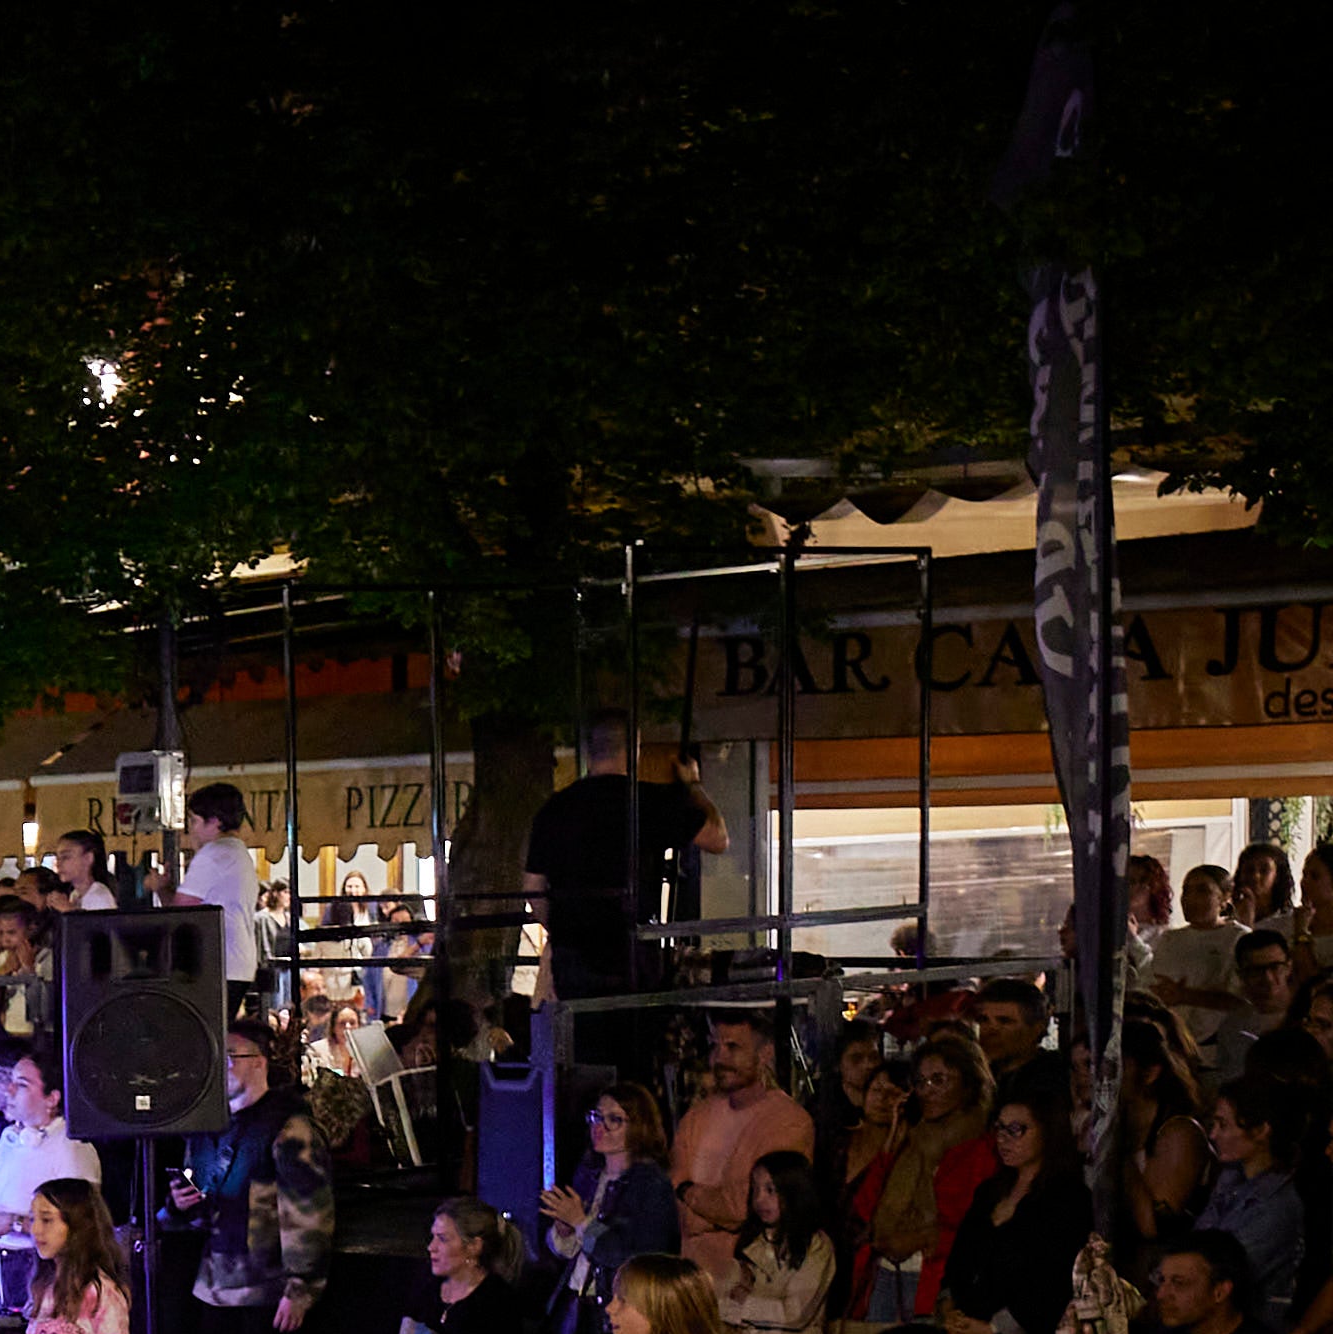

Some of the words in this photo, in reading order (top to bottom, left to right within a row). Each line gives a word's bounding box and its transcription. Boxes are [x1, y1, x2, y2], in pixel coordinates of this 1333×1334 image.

[717, 631, 889, 697] BAR
[916, 612, 1173, 692] CAA
[1206, 600, 1333, 677] JU
